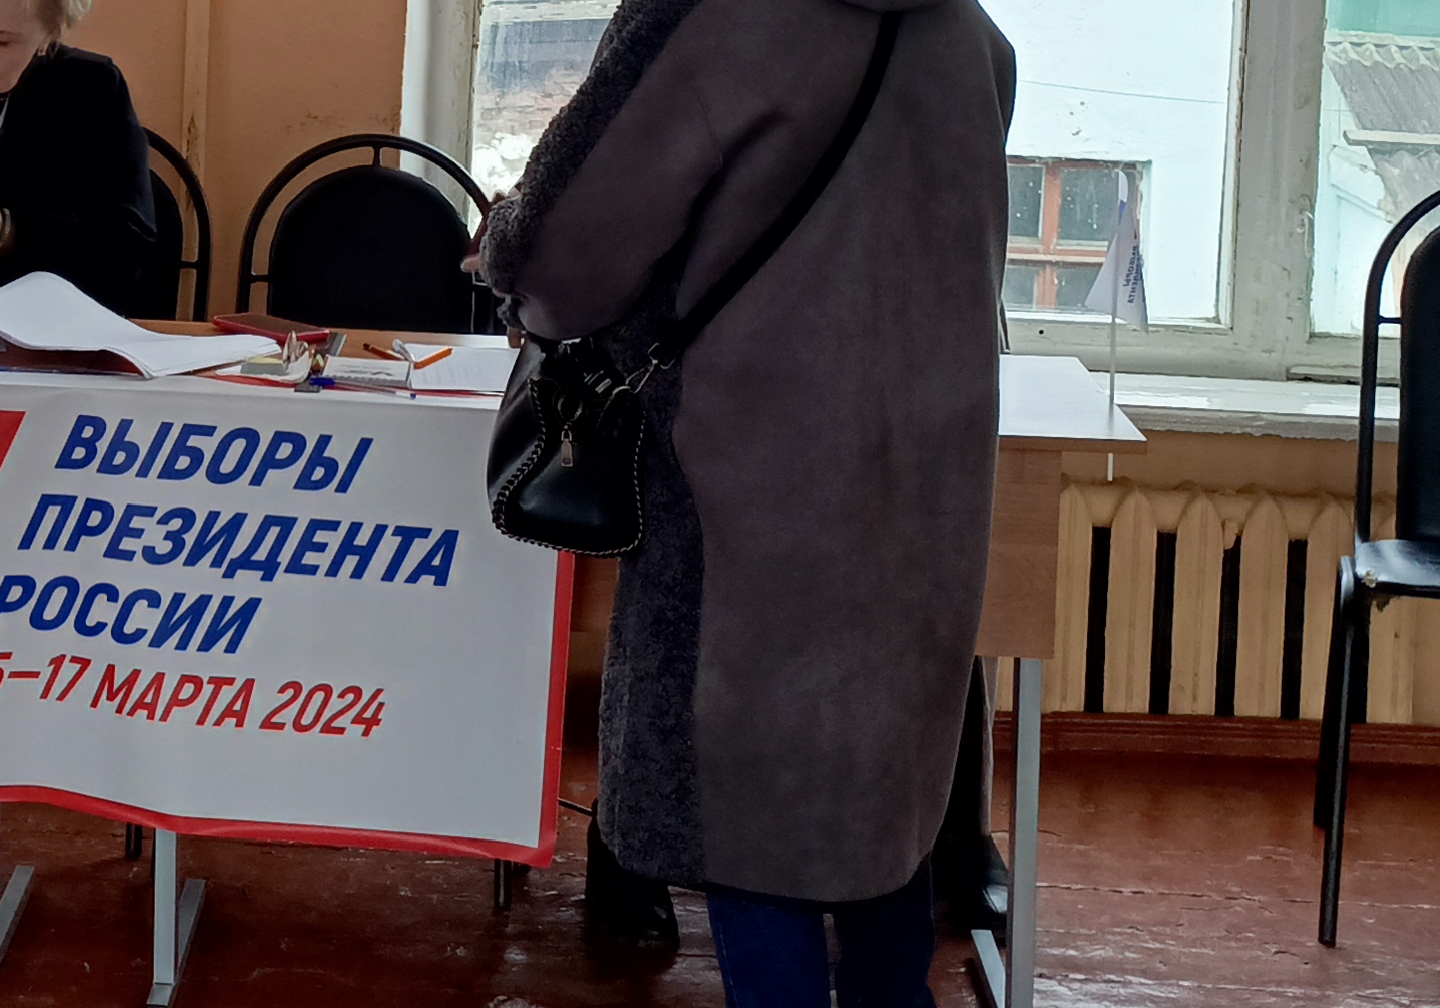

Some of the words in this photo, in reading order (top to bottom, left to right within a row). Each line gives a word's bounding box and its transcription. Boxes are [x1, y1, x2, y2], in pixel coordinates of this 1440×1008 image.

[55, 413, 373, 495] ВЫБОРЫ
[17, 493, 460, 589] ПРЕЗИДЕНТА
[90, 664, 256, 730] МАРТА
[258, 681, 386, 739] 2024
